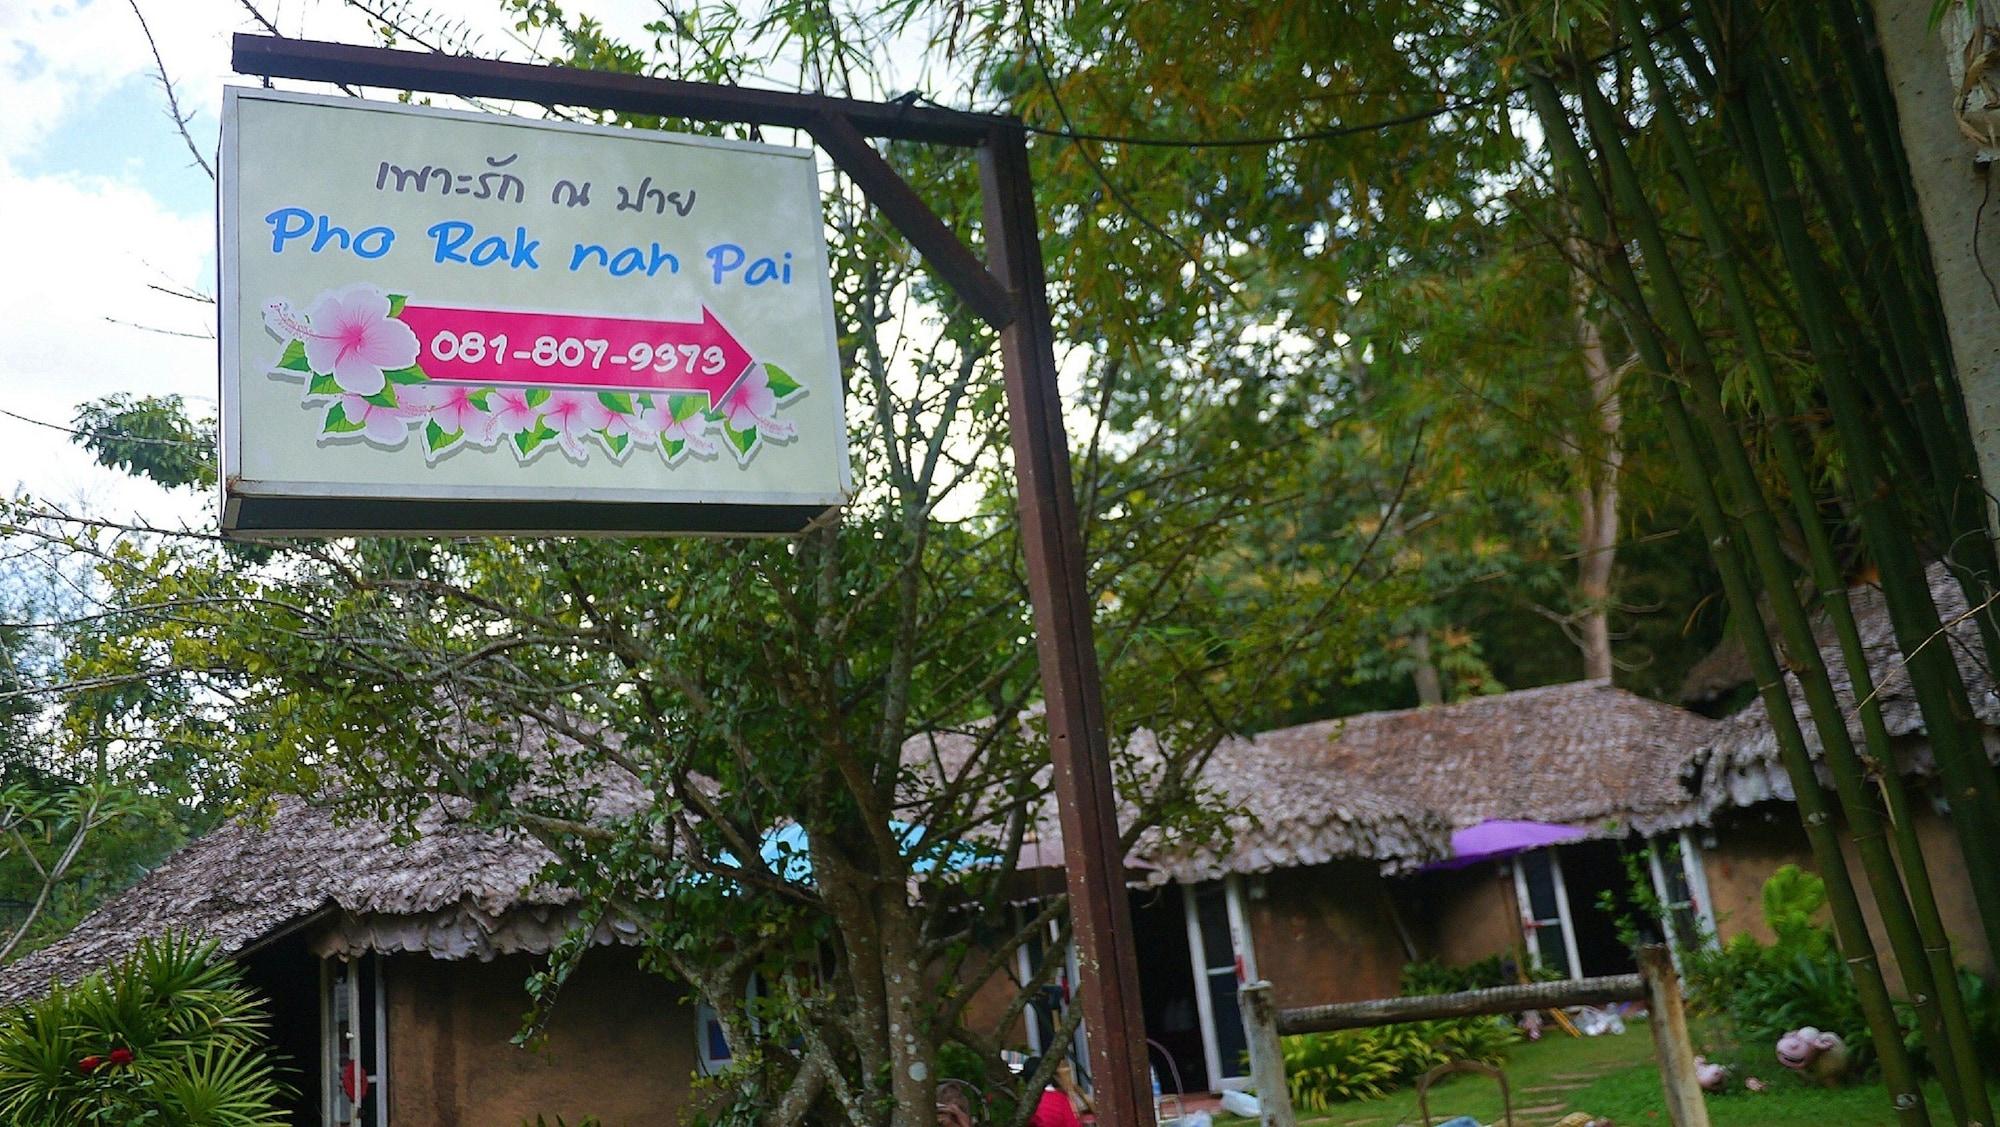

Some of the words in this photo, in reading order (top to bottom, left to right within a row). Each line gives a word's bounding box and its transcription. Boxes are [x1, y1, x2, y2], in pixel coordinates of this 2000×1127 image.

[376, 153, 525, 204] เพาะรัก
[552, 179, 591, 208] ณ
[616, 176, 697, 217] ปาย
[265, 207, 396, 259] Pho
[428, 220, 541, 271] Rak
[570, 239, 680, 278] nah
[706, 244, 793, 286] Pai
[430, 330, 727, 376] 081-807-9373
